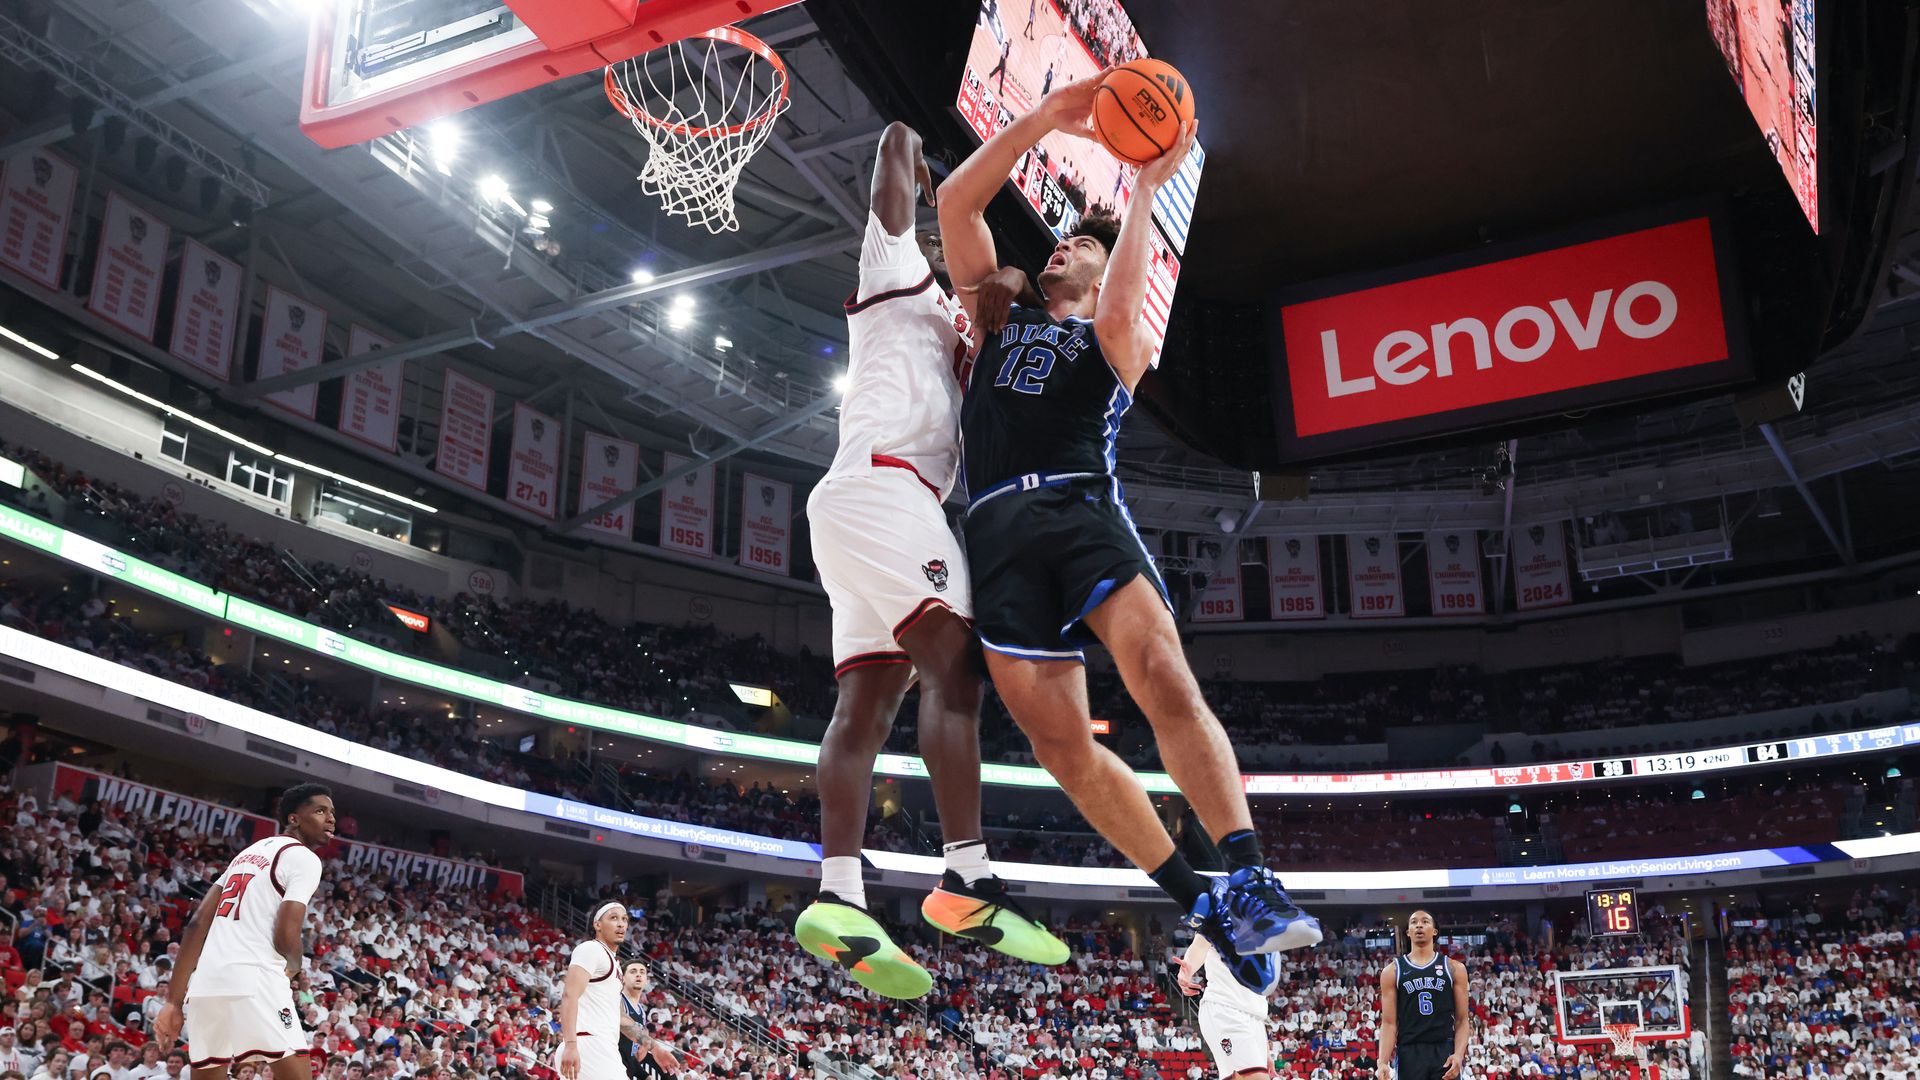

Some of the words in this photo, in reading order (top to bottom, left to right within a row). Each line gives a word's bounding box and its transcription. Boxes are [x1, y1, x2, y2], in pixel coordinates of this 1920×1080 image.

[1137, 88, 1167, 122] PRO
[1043, 186, 1062, 217] 13:19
[1000, 324, 1090, 362] DUKE
[1320, 280, 1679, 398] Lenovo
[994, 346, 1057, 395] 12
[516, 481, 548, 508] 27-0
[592, 511, 624, 531] 954
[670, 526, 705, 548] 1955
[749, 545, 783, 567] 1956
[1519, 559, 1562, 573] CHAMPIONS
[1275, 574, 1316, 584] CHAMPIONS
[1354, 572, 1397, 582] CHAMPIONS
[1434, 570, 1476, 579] CHAMPIONS
[1359, 595, 1395, 611] 1987
[1440, 592, 1476, 608] 1989
[1523, 582, 1564, 603] 2024
[1200, 599, 1235, 615] 1983
[1279, 596, 1315, 612] 1985
[228, 602, 260, 625] FUEL
[260, 614, 304, 639] POINTS
[433, 671, 462, 689] FUEL
[573, 708, 589, 720] UP
[589, 710, 605, 723] TO
[638, 721, 683, 736] GALLON
[1709, 754, 1730, 763] 2ND
[1756, 744, 1780, 761] 64
[1646, 755, 1696, 772] 13:19
[594, 810, 623, 827] Learn
[623, 816, 650, 832] More
[651, 823, 662, 833] at
[664, 823, 784, 853] LibertySeniorLiving.com
[1523, 869, 1555, 880] Learn
[1557, 867, 1586, 878] More
[1588, 865, 1600, 876] at
[1602, 855, 1741, 877] LibertySeniorLiving.com
[216, 873, 256, 921] 21
[1597, 893, 1632, 908] 13:19
[1607, 907, 1630, 931] 16
[1403, 977, 1446, 994] DUKE
[1418, 991, 1434, 1016] 6
